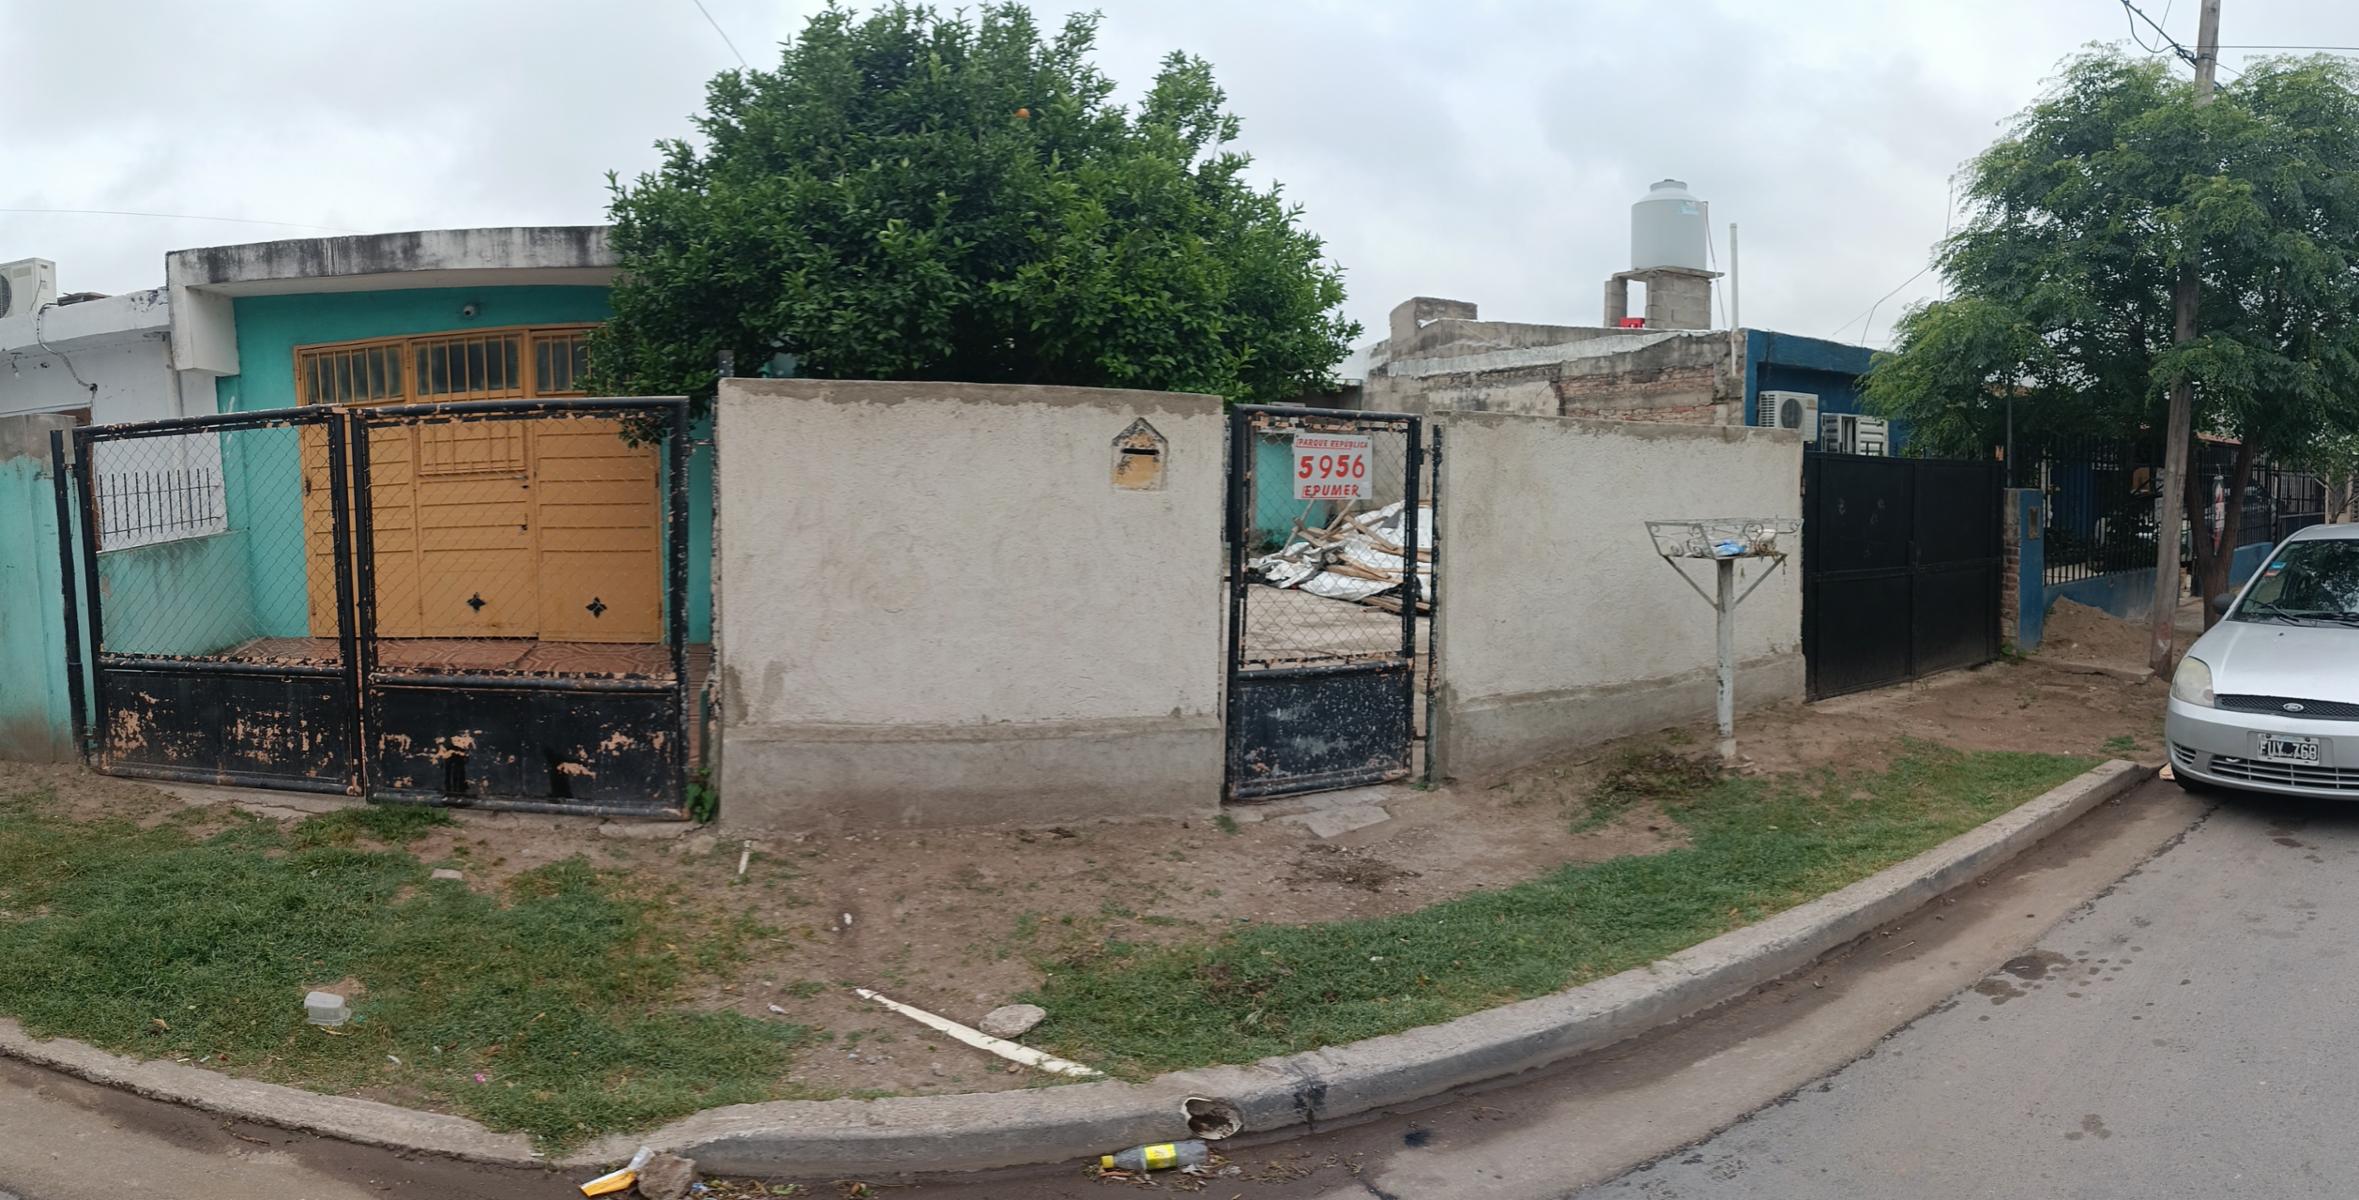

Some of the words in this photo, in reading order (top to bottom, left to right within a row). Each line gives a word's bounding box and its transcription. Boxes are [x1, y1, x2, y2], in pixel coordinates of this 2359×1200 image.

[1297, 438, 1328, 447] PARQUE
[1298, 454, 1365, 479] 5956
[1303, 484, 1361, 497] EPUMER
[2260, 740, 2284, 757] FUY
[2292, 743, 2317, 760] 768
